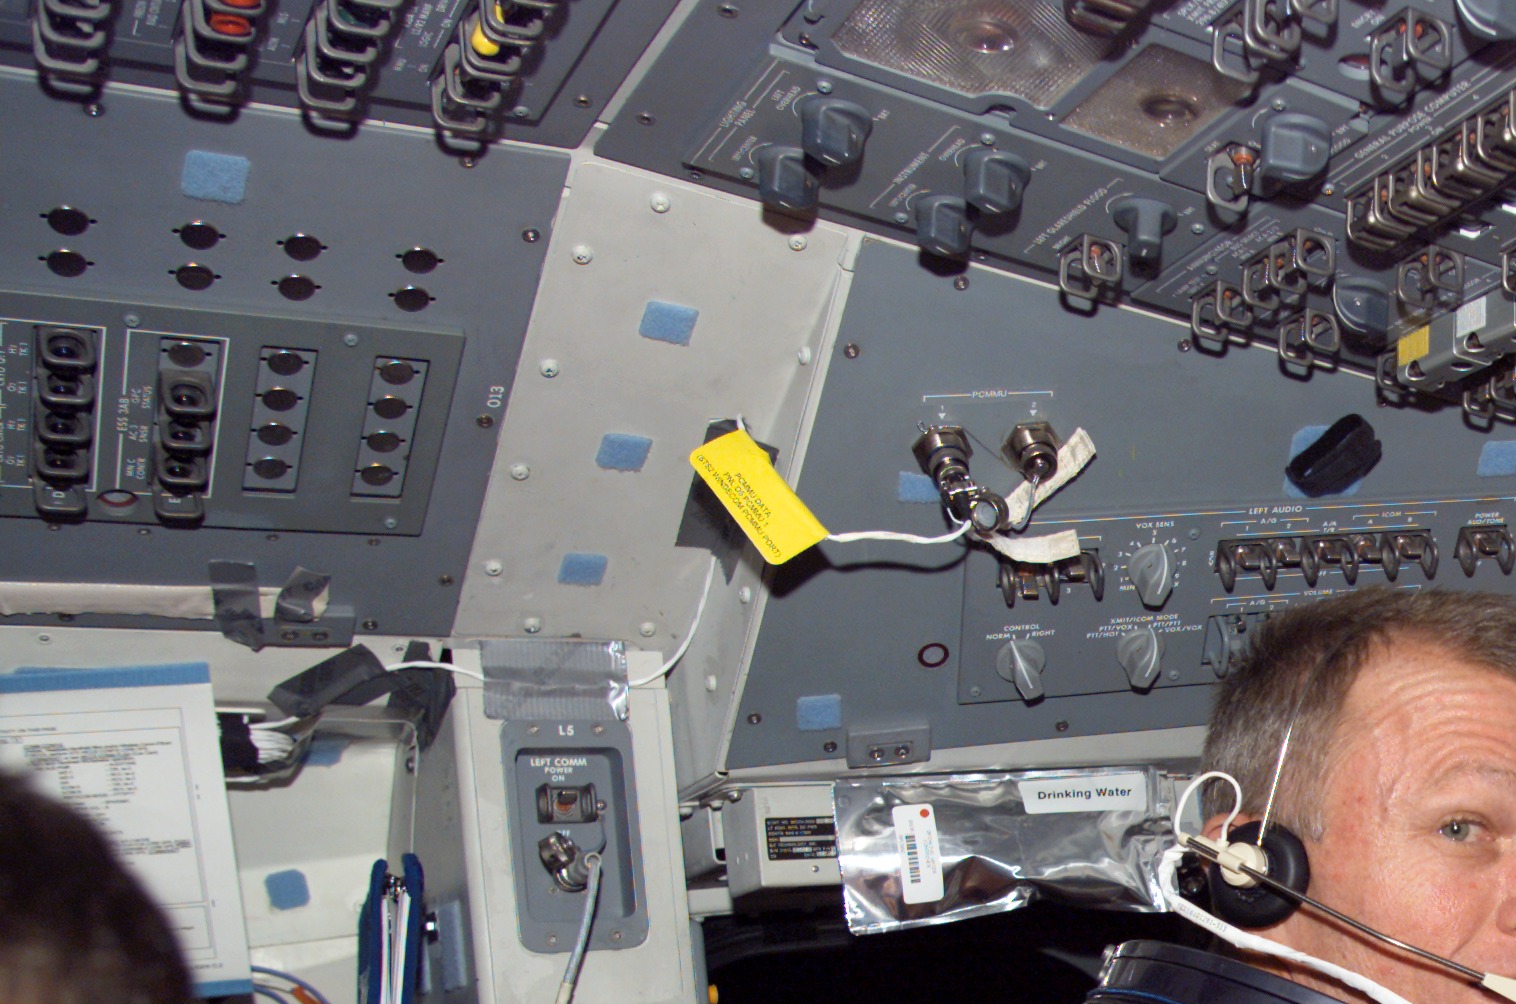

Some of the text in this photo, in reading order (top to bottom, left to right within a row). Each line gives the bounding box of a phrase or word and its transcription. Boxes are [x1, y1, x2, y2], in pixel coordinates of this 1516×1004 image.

[972, 390, 1008, 398] PCMMU
[755, 497, 771, 518] DATA
[1272, 505, 1303, 513] AUDIO
[1004, 624, 1040, 632] CONTROL
[986, 629, 1055, 641] NORM RIGHT
[531, 758, 588, 766] LEFT COMM
[1038, 788, 1133, 800] Drinking Water
